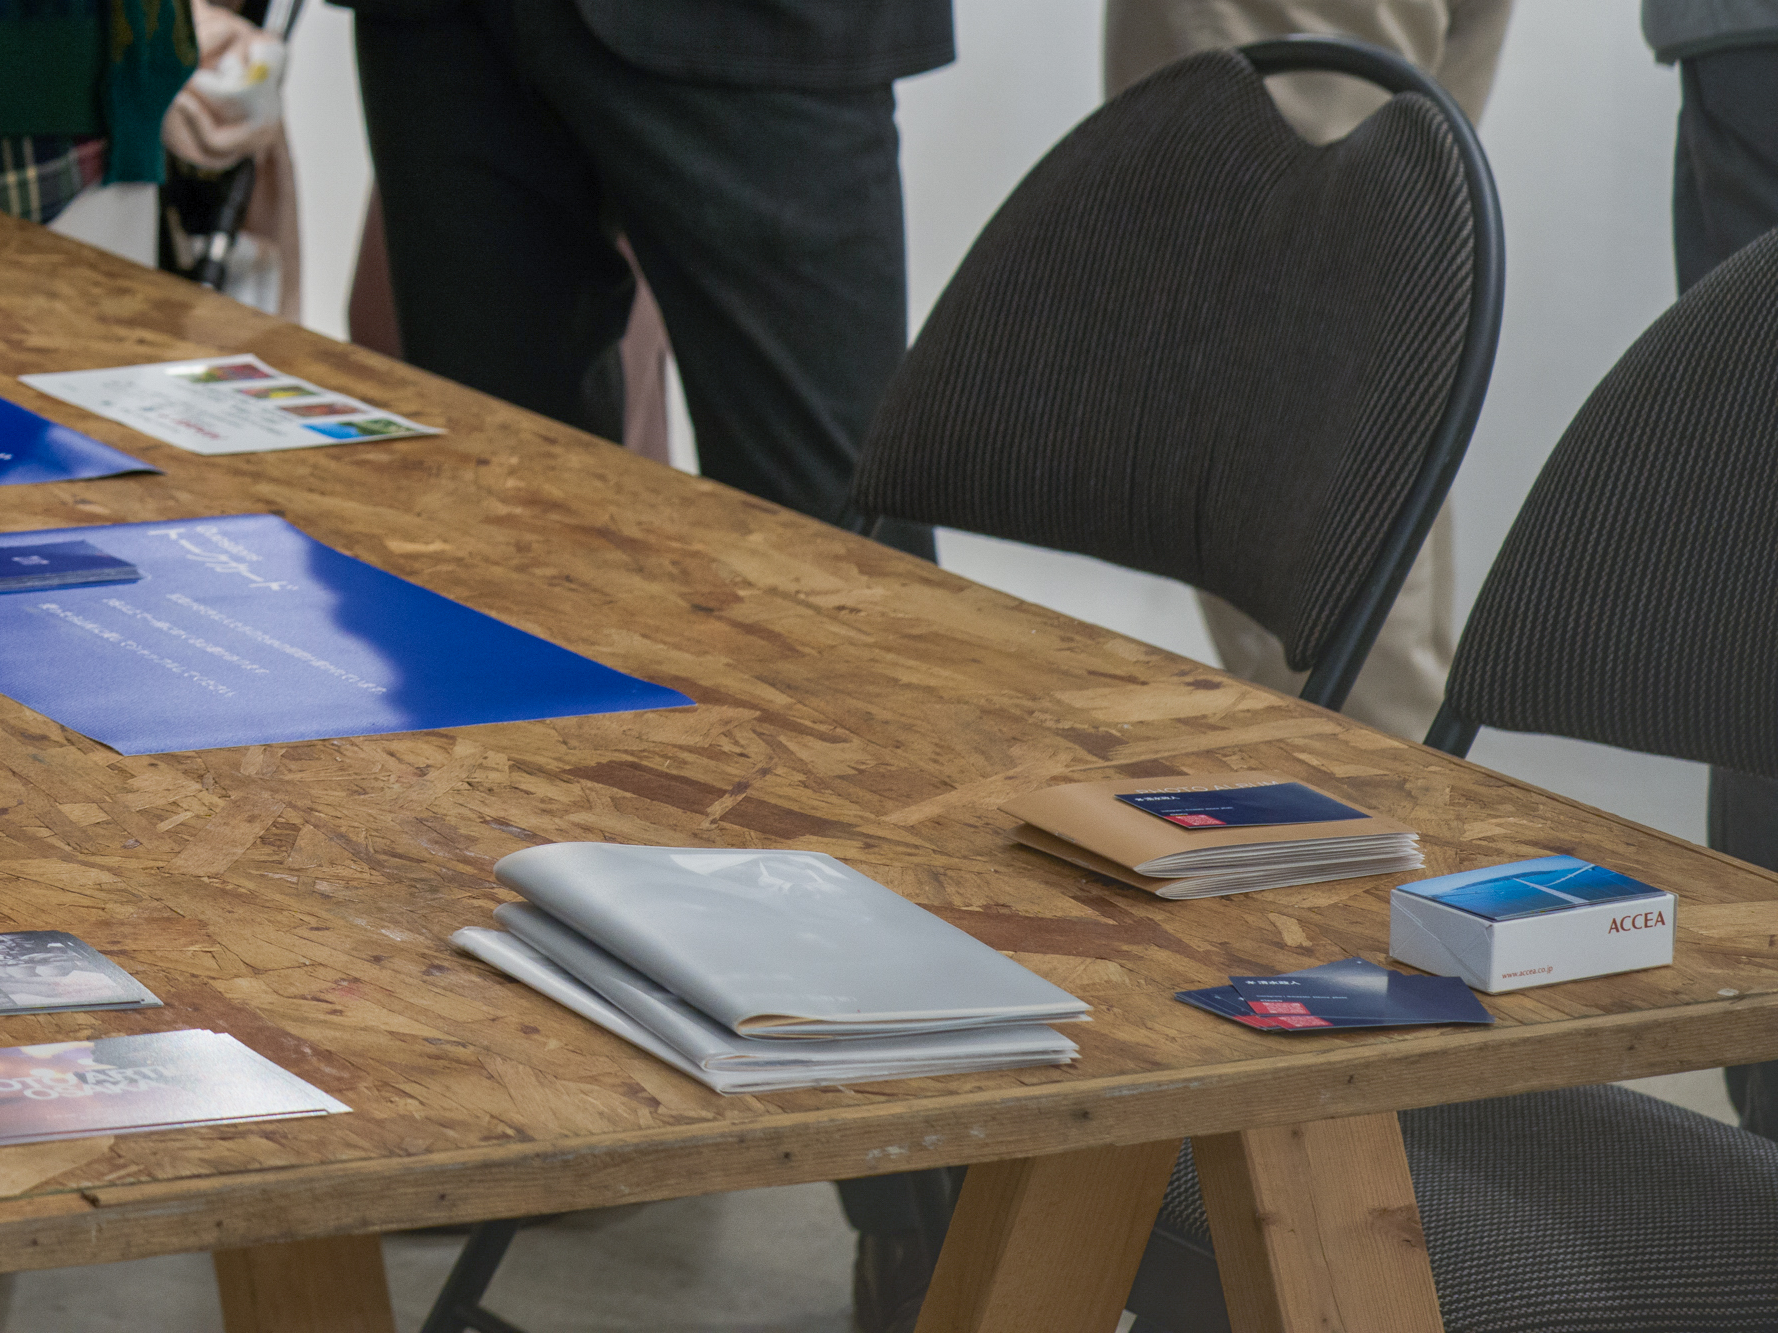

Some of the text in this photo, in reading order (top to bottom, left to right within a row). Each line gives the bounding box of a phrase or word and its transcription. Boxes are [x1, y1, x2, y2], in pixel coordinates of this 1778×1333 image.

[147, 528, 299, 591] トークカード
[1135, 786, 1208, 794] PHOTO
[1608, 910, 1666, 934] ACCEA
[1501, 965, 1554, 979] www.accea.co.jp
[23, 1078, 166, 1101] OSAKA
